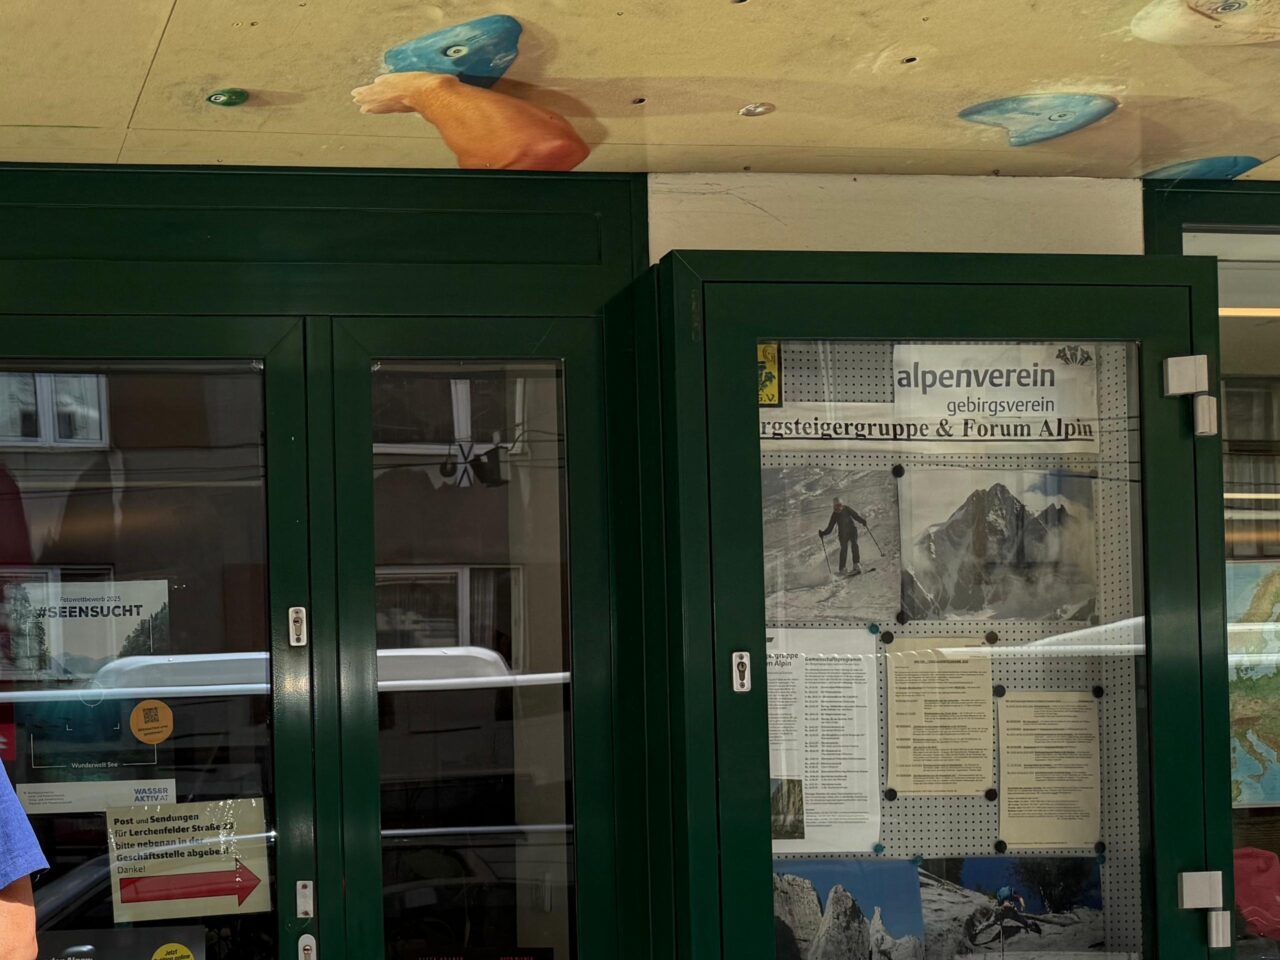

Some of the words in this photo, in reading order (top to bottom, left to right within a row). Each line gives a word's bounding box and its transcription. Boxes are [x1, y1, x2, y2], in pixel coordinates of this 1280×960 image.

[897, 362, 1055, 394] alpenverein
[947, 397, 1055, 416] gebirgsverein
[760, 417, 929, 439] rgsteigergruppe
[936, 419, 953, 437] &
[962, 419, 1032, 437] Forum
[1039, 418, 1093, 439] Alpin
[37, 605, 143, 618] #SEENSUCHT
[134, 787, 168, 795] WASSER
[114, 817, 134, 825] Post
[150, 814, 199, 824] Sendungen
[115, 828, 128, 837] für
[129, 824, 190, 837] Lerchenfelder
[192, 822, 221, 832] Straße
[222, 822, 234, 830] 23
[116, 841, 136, 850] bitte
[137, 839, 176, 848] nebenan
[178, 837, 187, 845] in
[117, 850, 185, 862] Geschäftsstelle
[117, 865, 146, 874] Danke!
